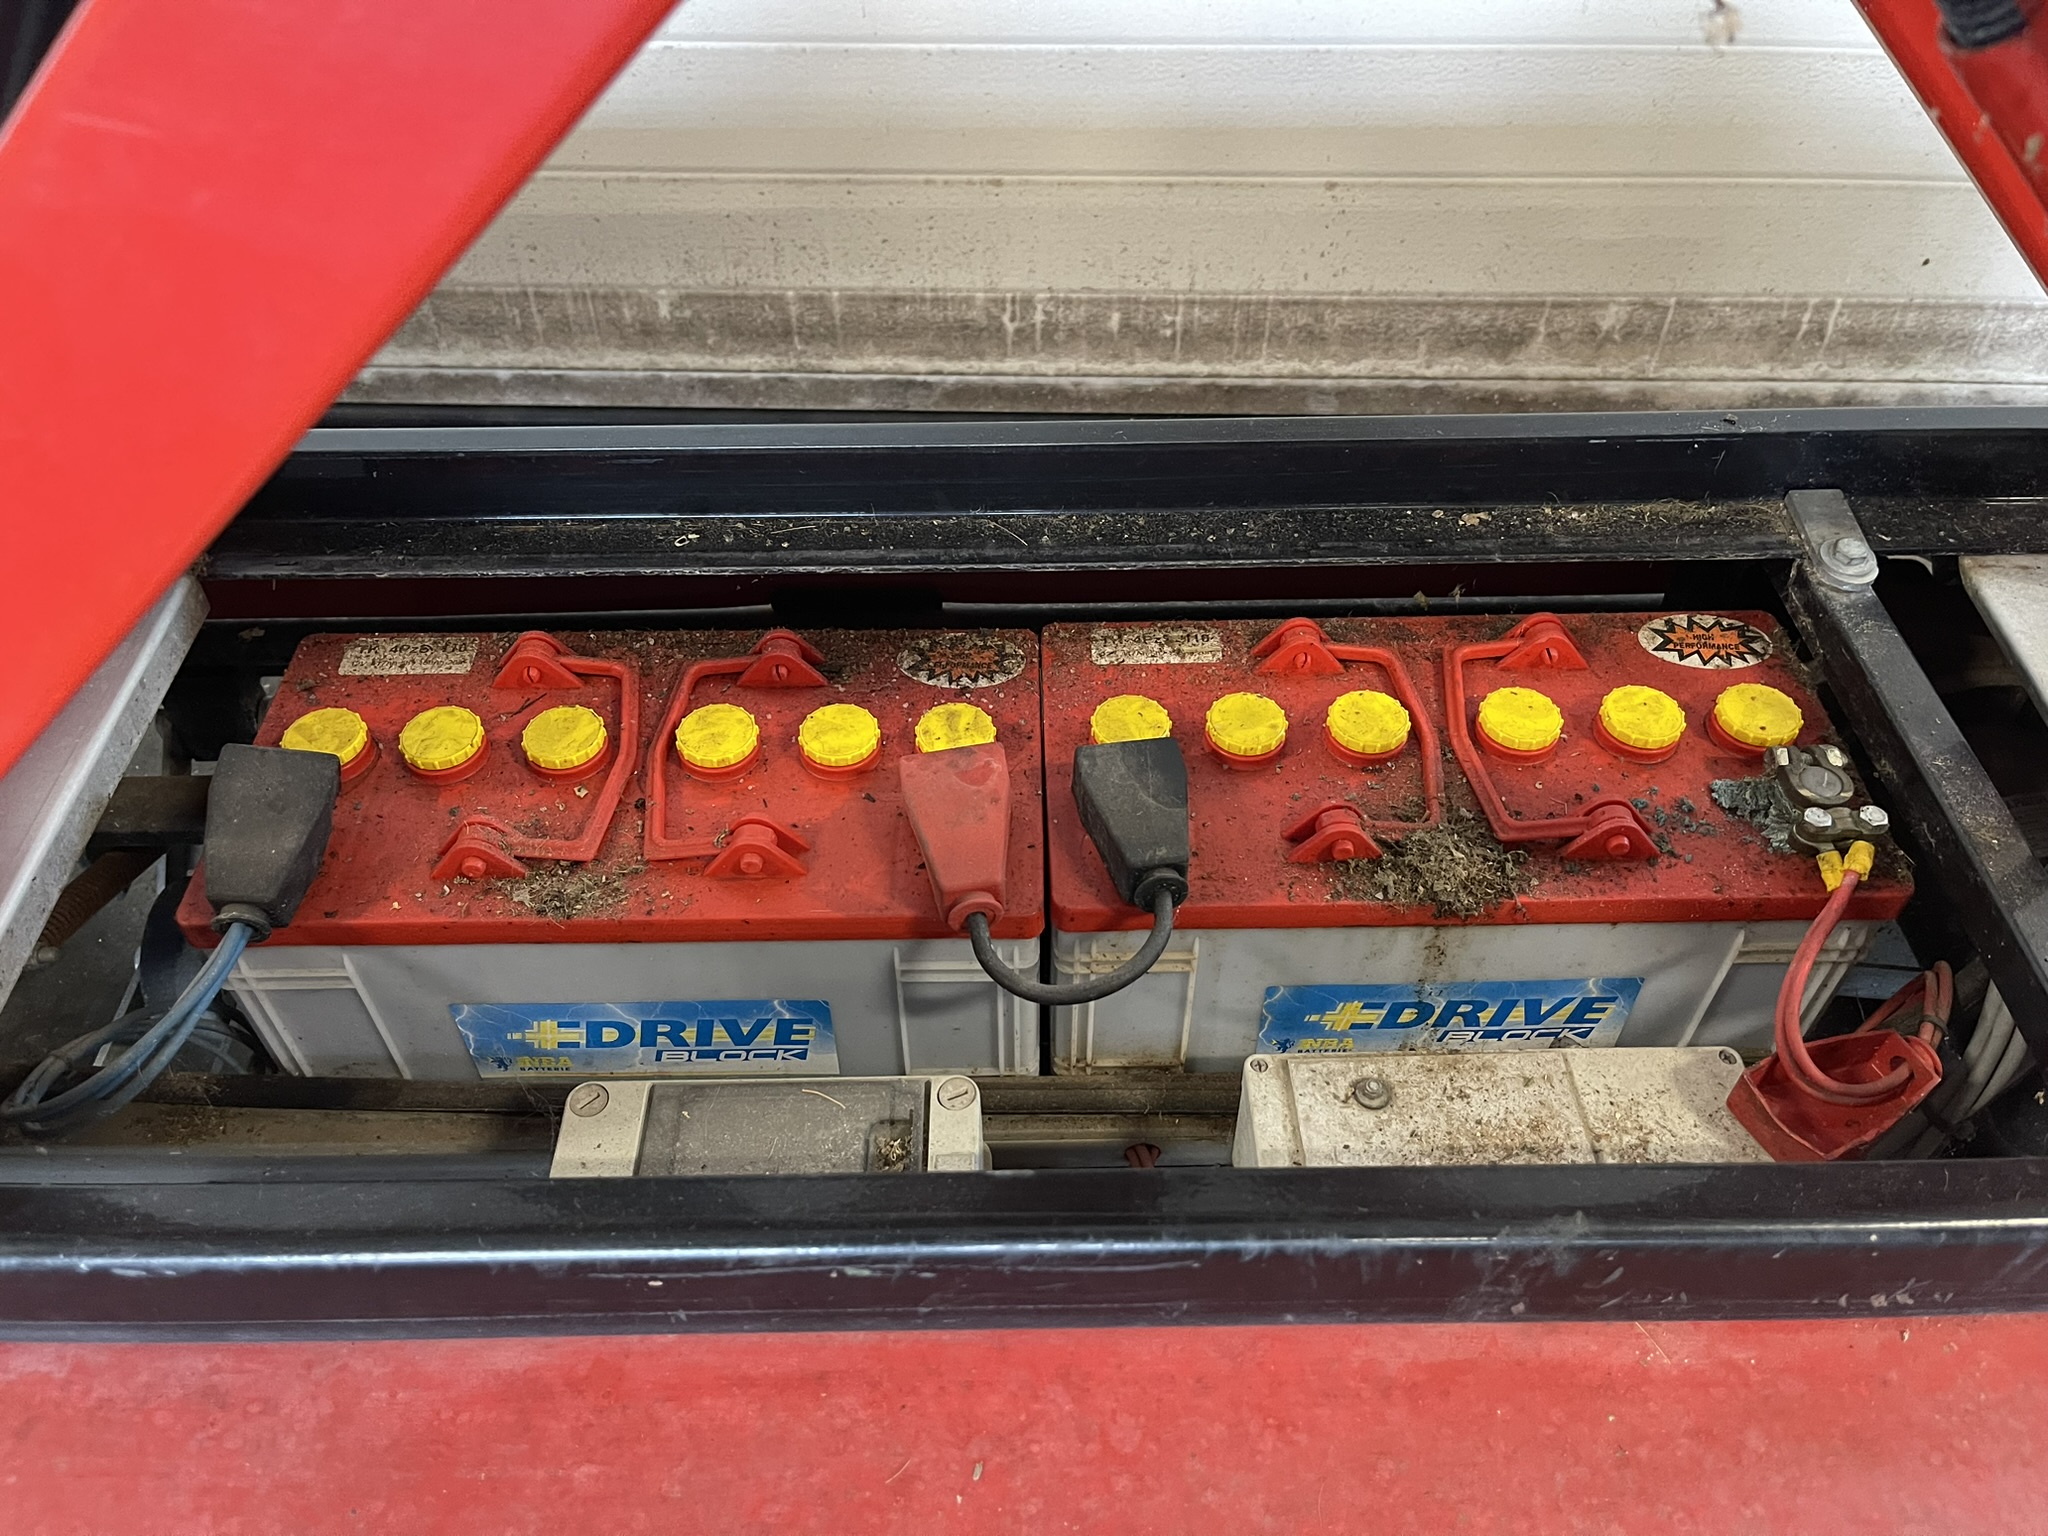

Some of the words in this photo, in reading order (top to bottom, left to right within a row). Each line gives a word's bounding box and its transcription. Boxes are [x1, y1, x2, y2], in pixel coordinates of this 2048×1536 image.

[1692, 633, 1714, 641] HIGH
[1673, 641, 1740, 651] PERFORMANCE
[1438, 1027, 1595, 1043] BLOCK
[660, 1049, 809, 1063] BLOCK
